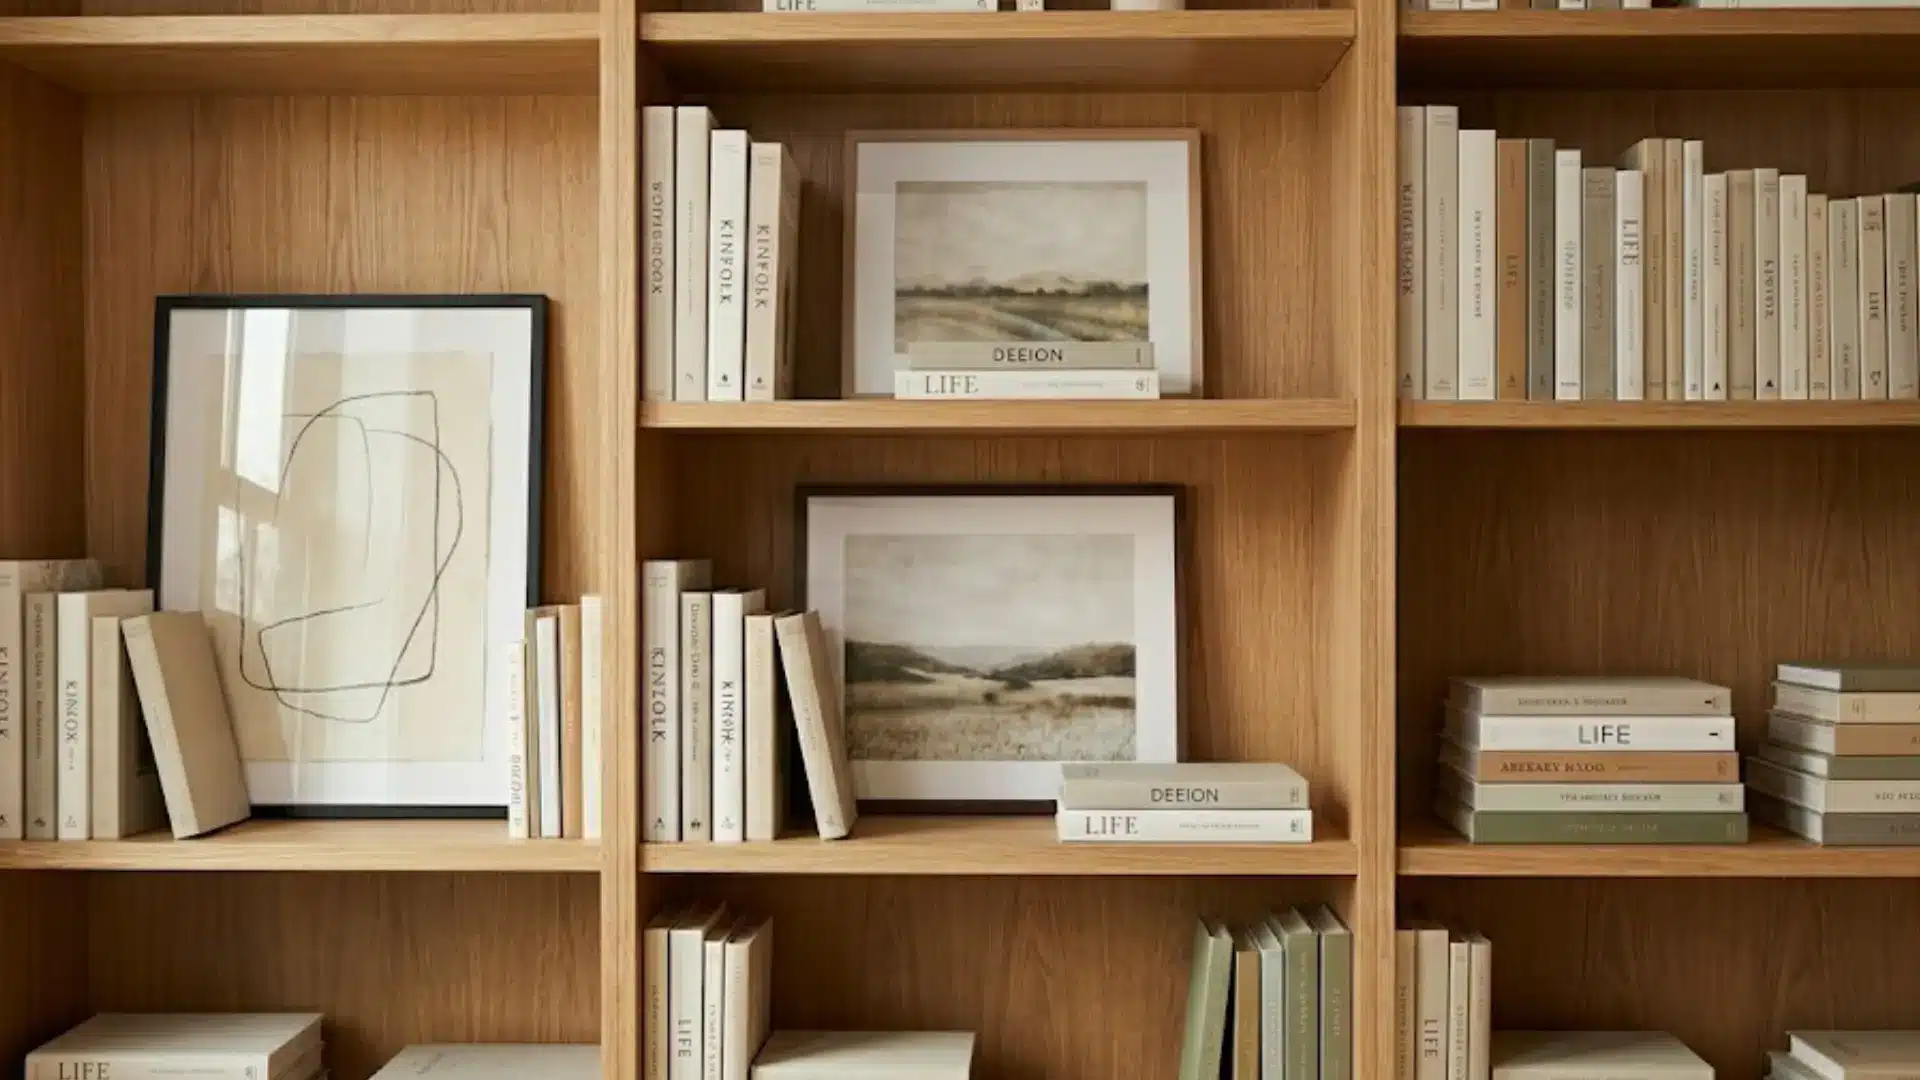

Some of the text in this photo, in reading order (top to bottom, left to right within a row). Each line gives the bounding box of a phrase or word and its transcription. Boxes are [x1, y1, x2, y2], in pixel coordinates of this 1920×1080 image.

[755, 223, 770, 310] KINFOLK
[924, 374, 980, 395] LIFE
[1577, 723, 1632, 746] LIFE
[1085, 815, 1140, 836] LIFE
[677, 1018, 692, 1059] LIFE
[1424, 1018, 1439, 1059] LIFE
[58, 1061, 111, 1080] LIFE
